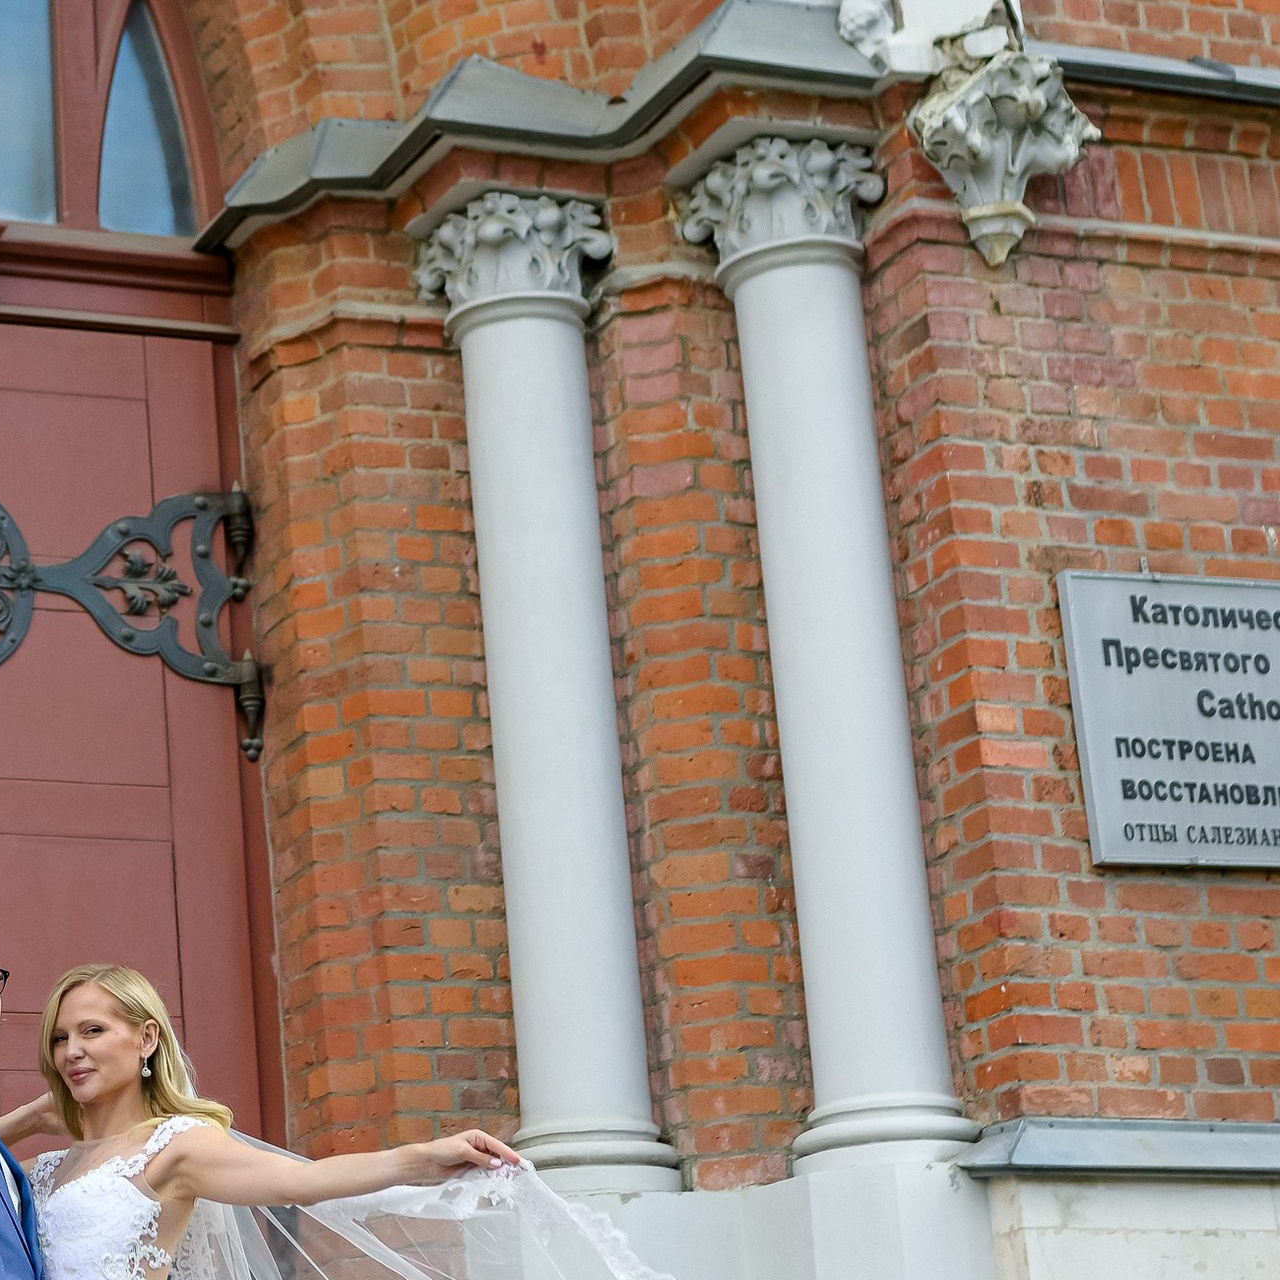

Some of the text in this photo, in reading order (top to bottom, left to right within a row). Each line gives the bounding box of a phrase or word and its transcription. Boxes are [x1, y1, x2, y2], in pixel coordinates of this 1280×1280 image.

[1101, 638, 1271, 675] Пресвятого
[1196, 689, 1280, 721] Catho
[1115, 737, 1256, 764] ПОСТРОЕНА
[1121, 778, 1280, 807] ВОССТАНОВЛ
[1123, 822, 1178, 844] ОТЦЫ
